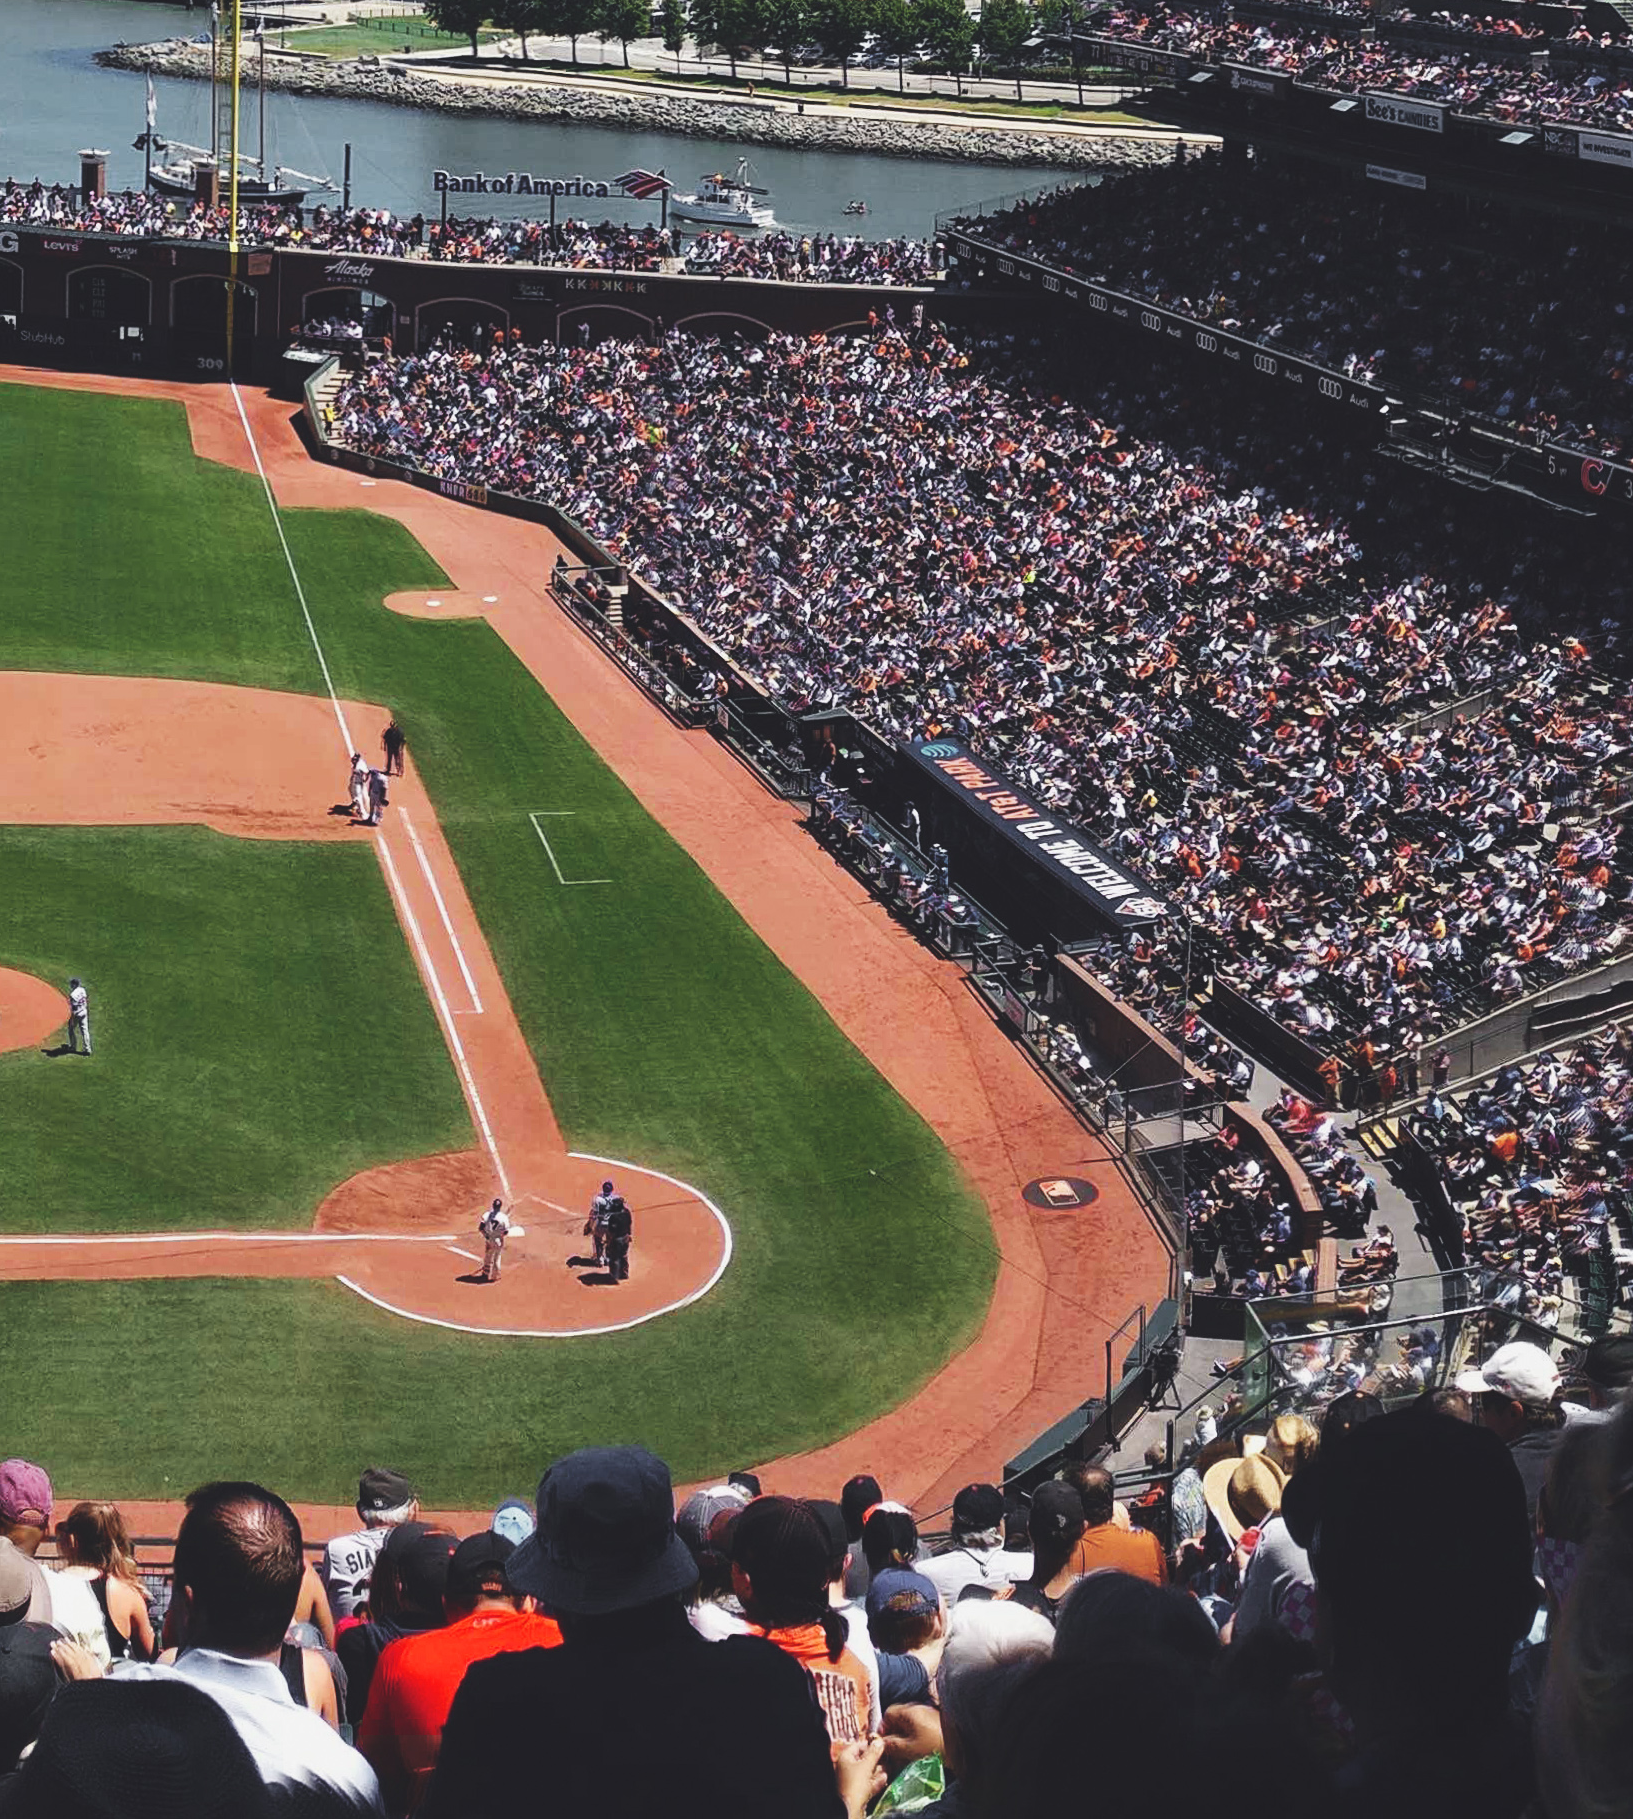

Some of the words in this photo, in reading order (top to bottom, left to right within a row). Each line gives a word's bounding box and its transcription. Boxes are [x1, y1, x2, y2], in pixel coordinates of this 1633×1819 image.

[1367, 98, 1397, 122] See's
[434, 170, 492, 193] Bank
[492, 172, 516, 194] of
[517, 173, 608, 198] America
[324, 258, 374, 276] Alaska
[21, 330, 65, 345] StubHub
[197, 356, 224, 369] 309
[1548, 455, 1556, 474] 5
[1624, 479, 1633, 498] 3
[935, 756, 998, 790] PARK
[975, 789, 1040, 821] AT&T
[1016, 820, 1054, 841] TO
[1039, 838, 1140, 900] WELCOME
[345, 1548, 380, 1575] SIA
